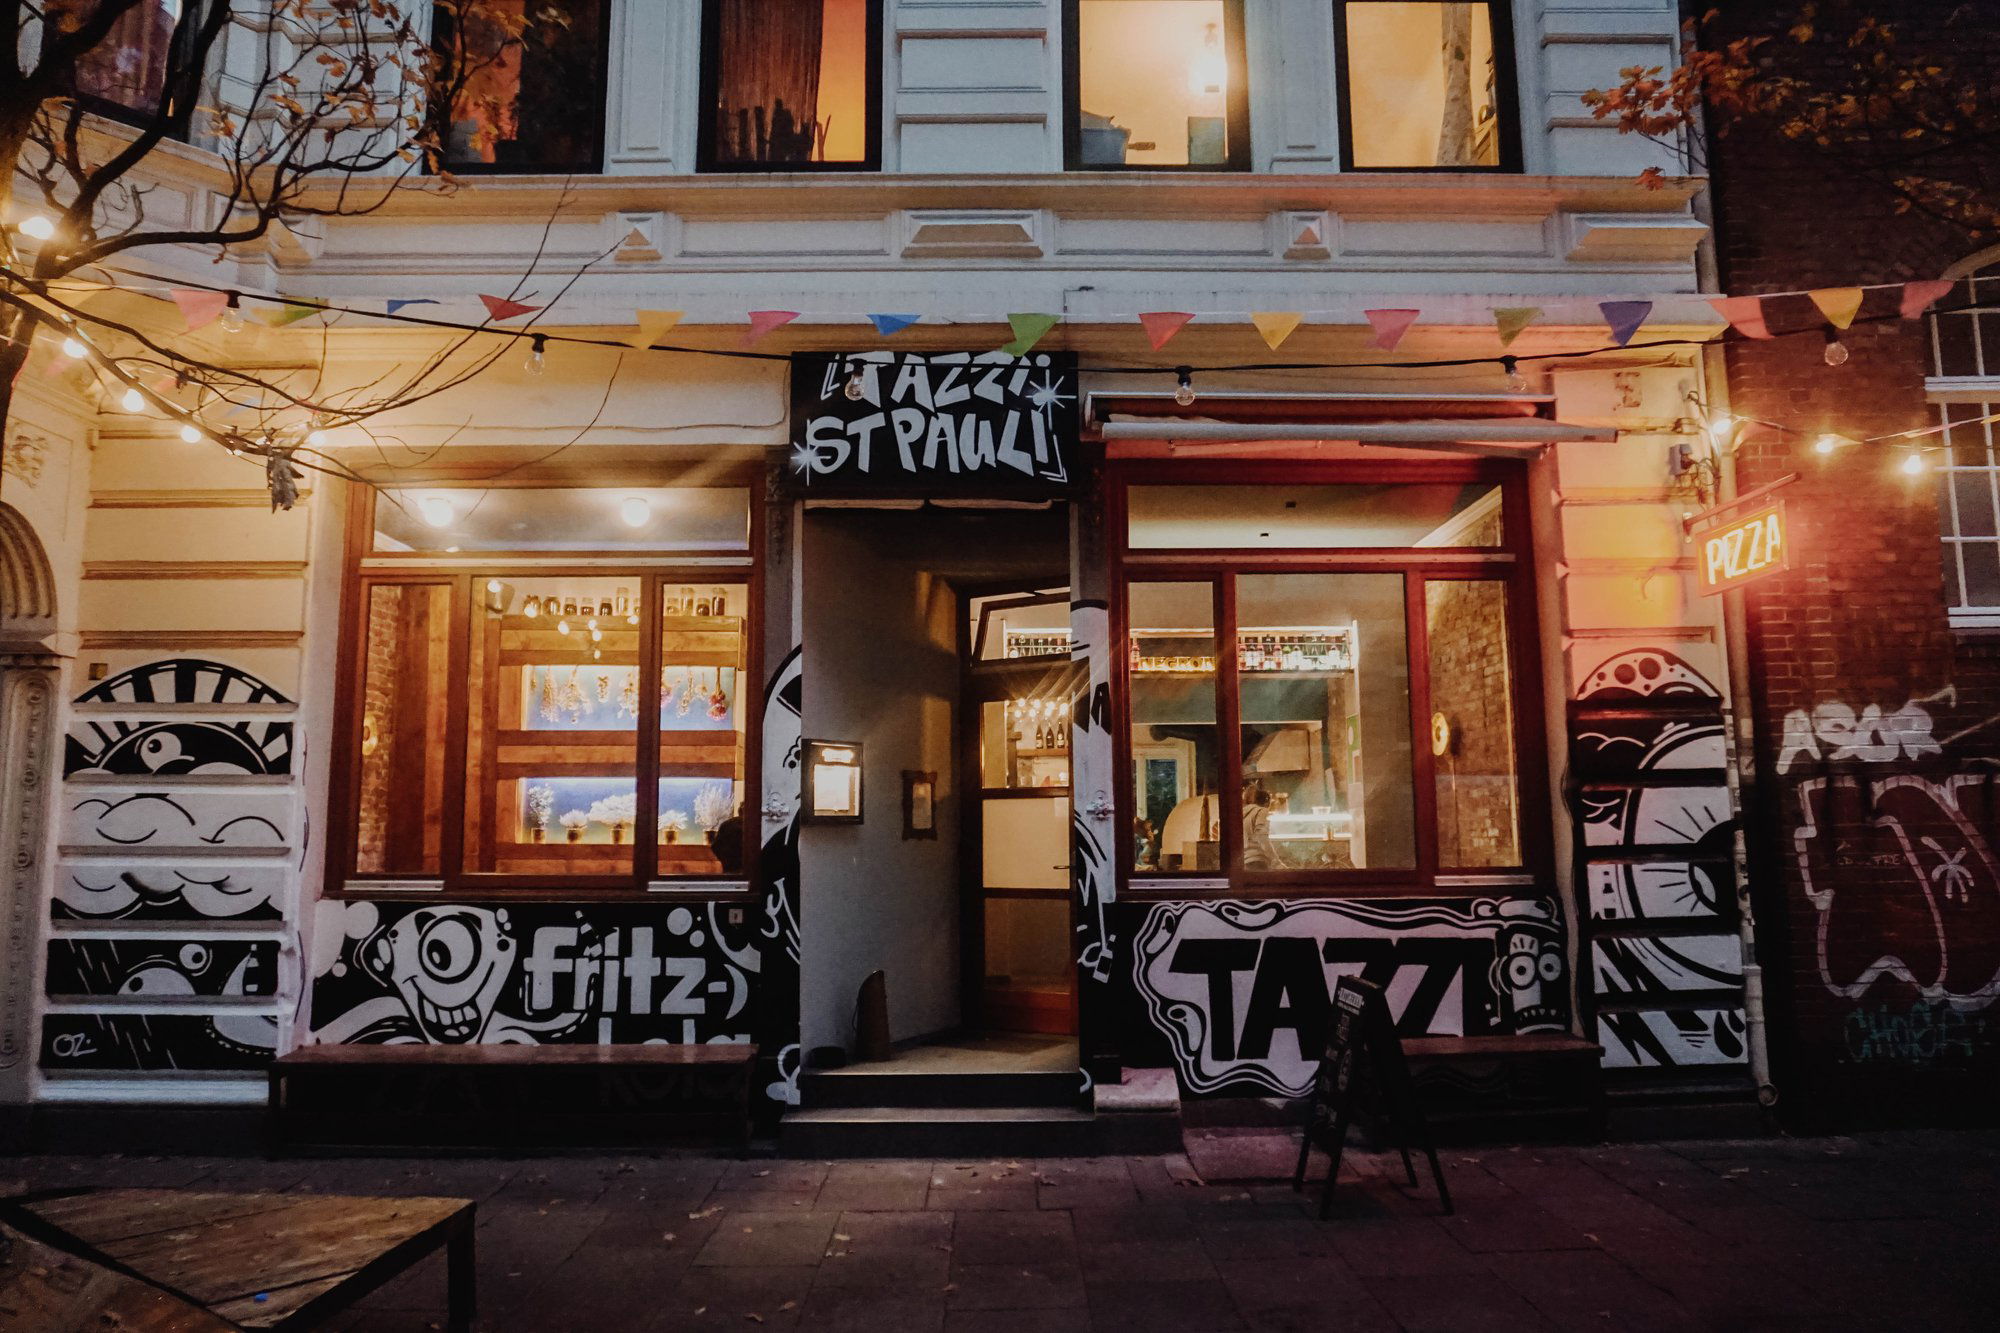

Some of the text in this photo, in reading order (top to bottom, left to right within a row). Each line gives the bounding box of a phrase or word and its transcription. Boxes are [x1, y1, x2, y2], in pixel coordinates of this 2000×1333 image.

[806, 407, 1048, 477] ST PAULI
[1705, 514, 1781, 585] PIZZA
